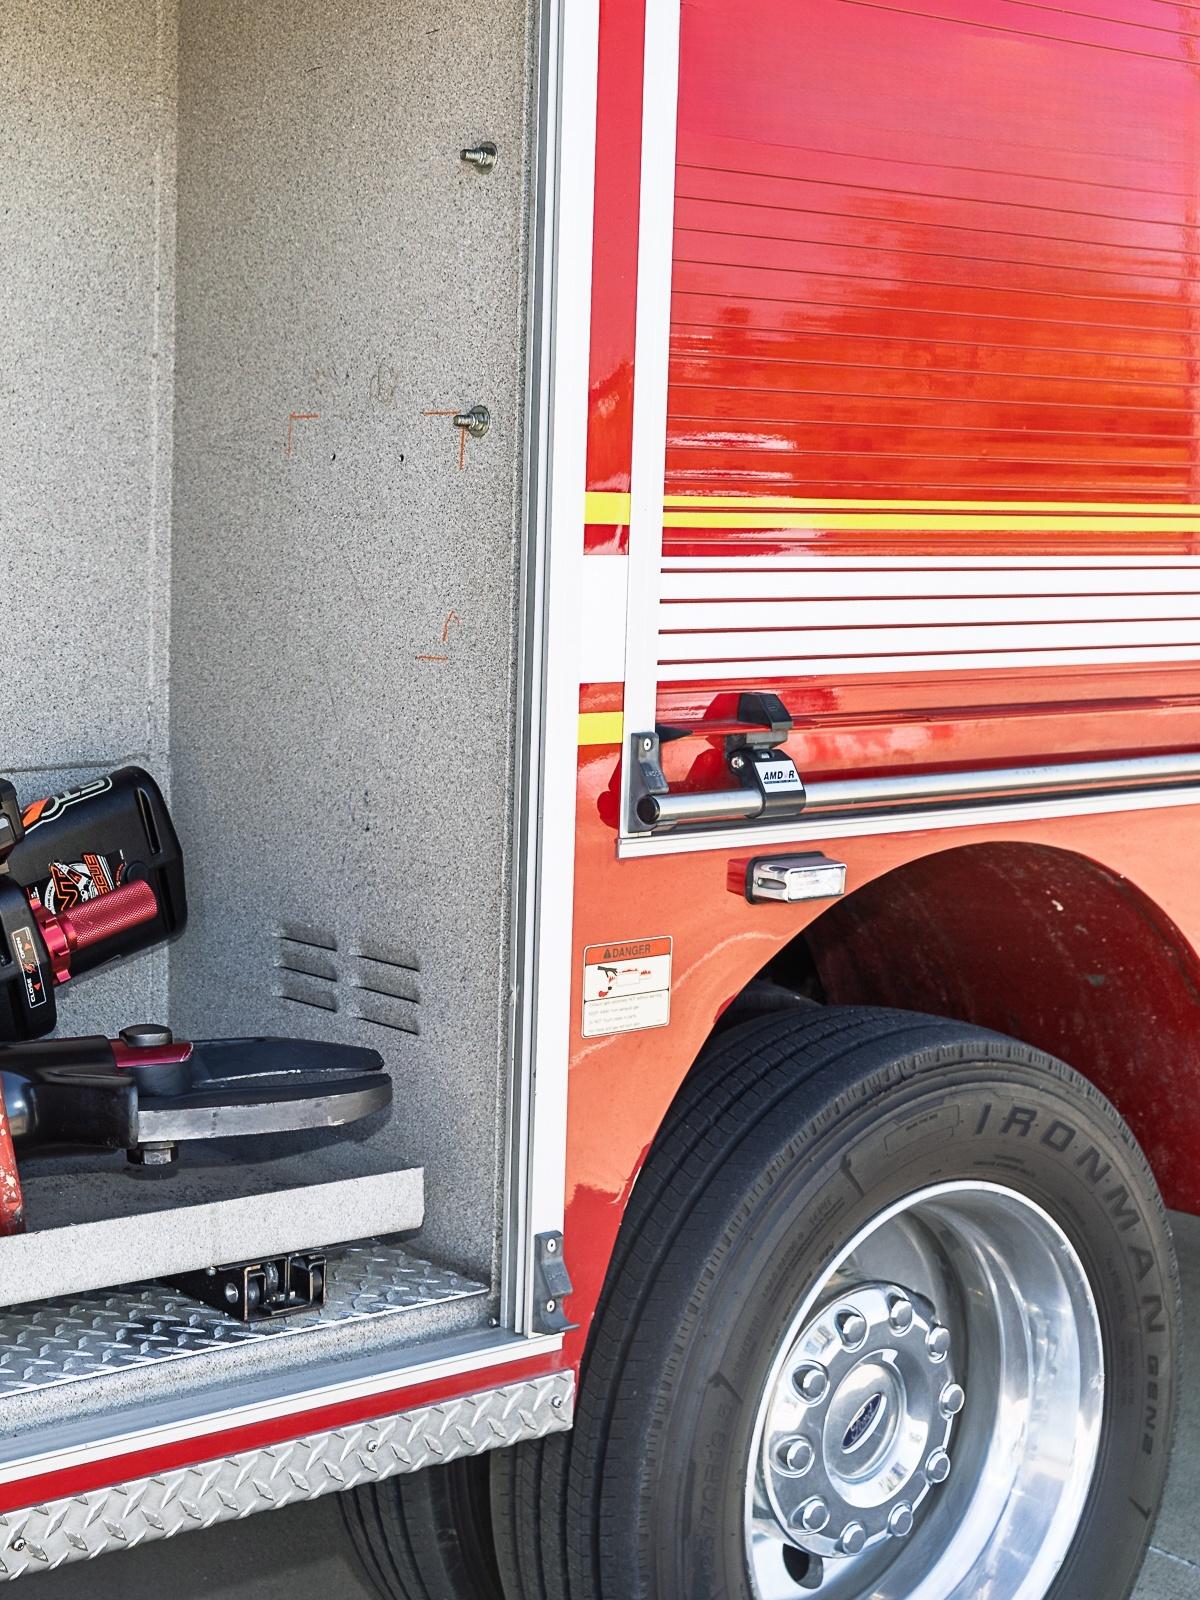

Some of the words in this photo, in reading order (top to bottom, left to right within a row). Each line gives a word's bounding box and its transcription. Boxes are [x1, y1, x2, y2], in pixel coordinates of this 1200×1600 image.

[612, 944, 651, 959] DANGER
[26, 977, 36, 1003] CLOSE
[975, 1102, 1165, 1333] IRONMAN
